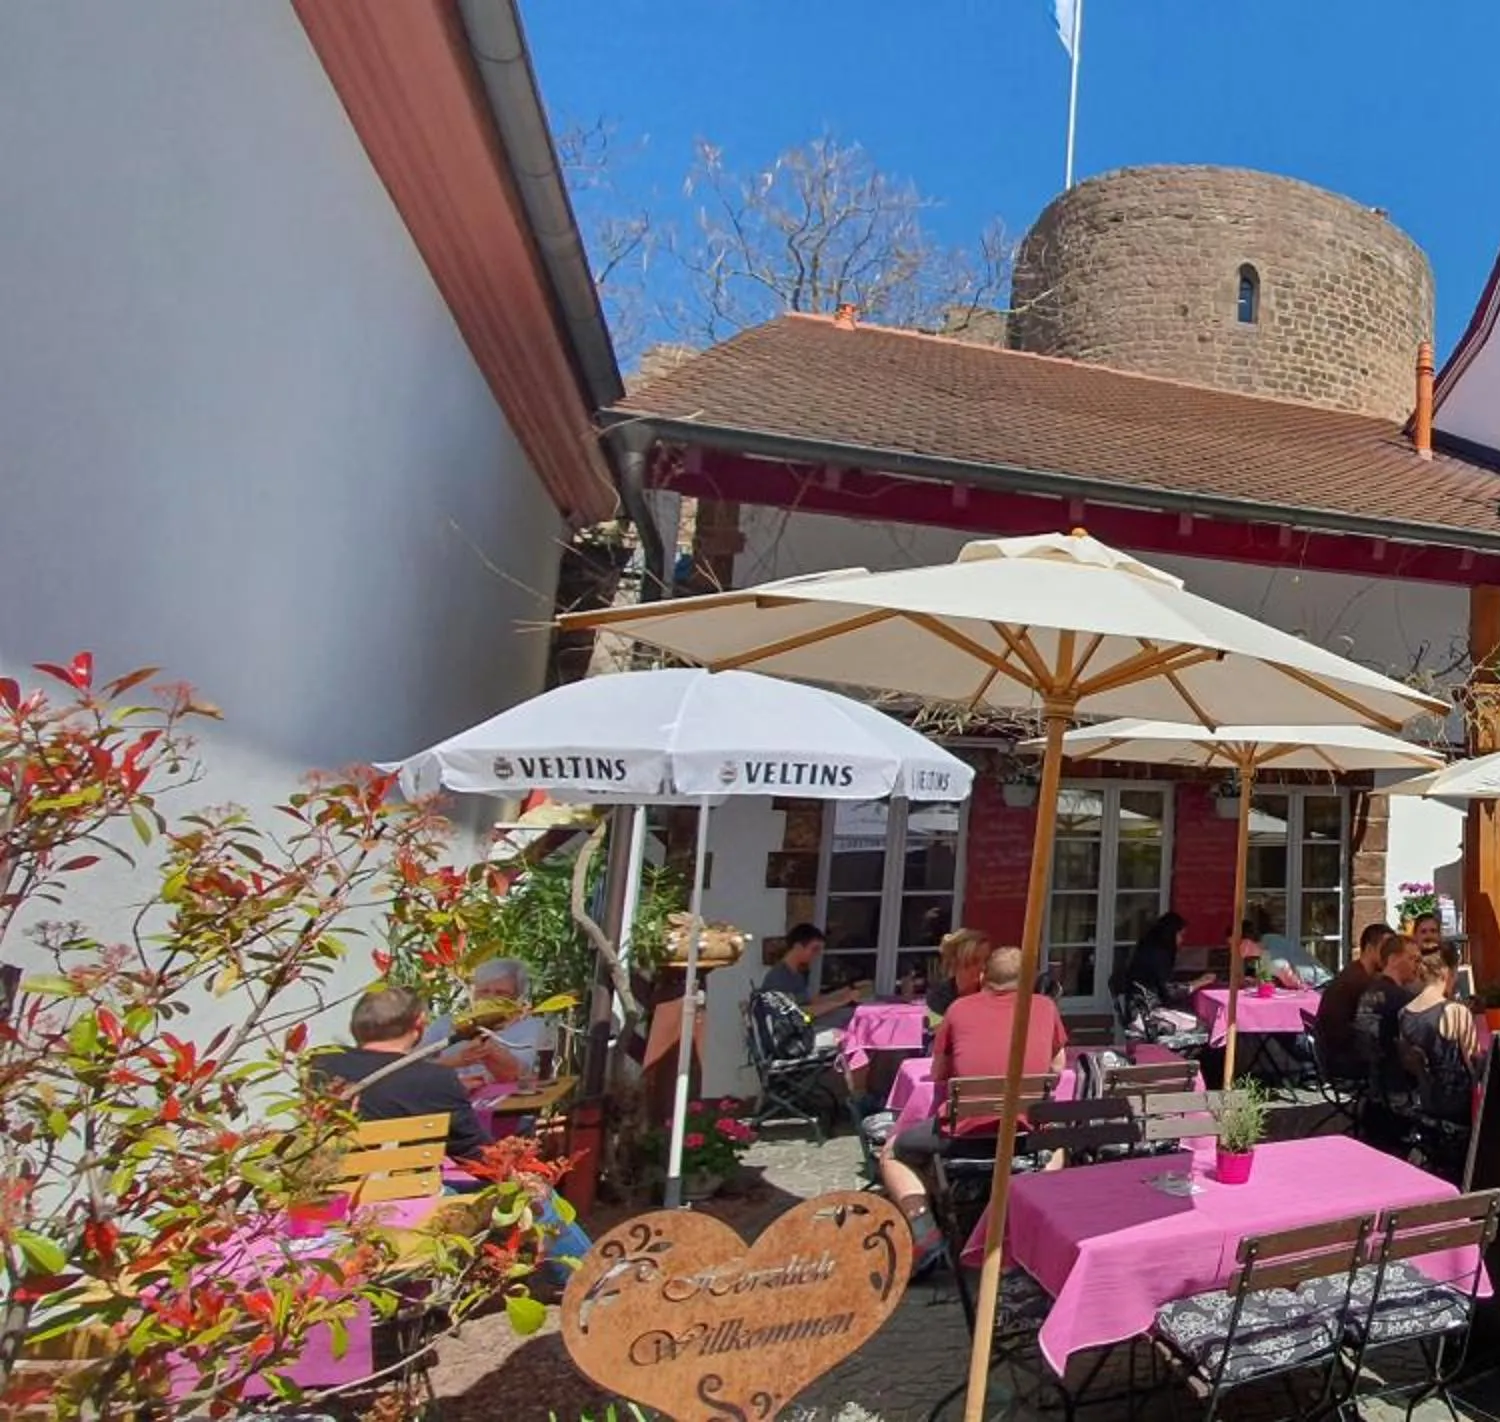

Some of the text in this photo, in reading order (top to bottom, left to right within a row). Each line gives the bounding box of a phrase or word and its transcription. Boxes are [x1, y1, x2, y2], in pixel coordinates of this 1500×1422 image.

[517, 756, 627, 782] VELTINS
[744, 761, 854, 787] VELTINS
[661, 1249, 837, 1303] Herzlich
[629, 1311, 855, 1367] Willkommen
